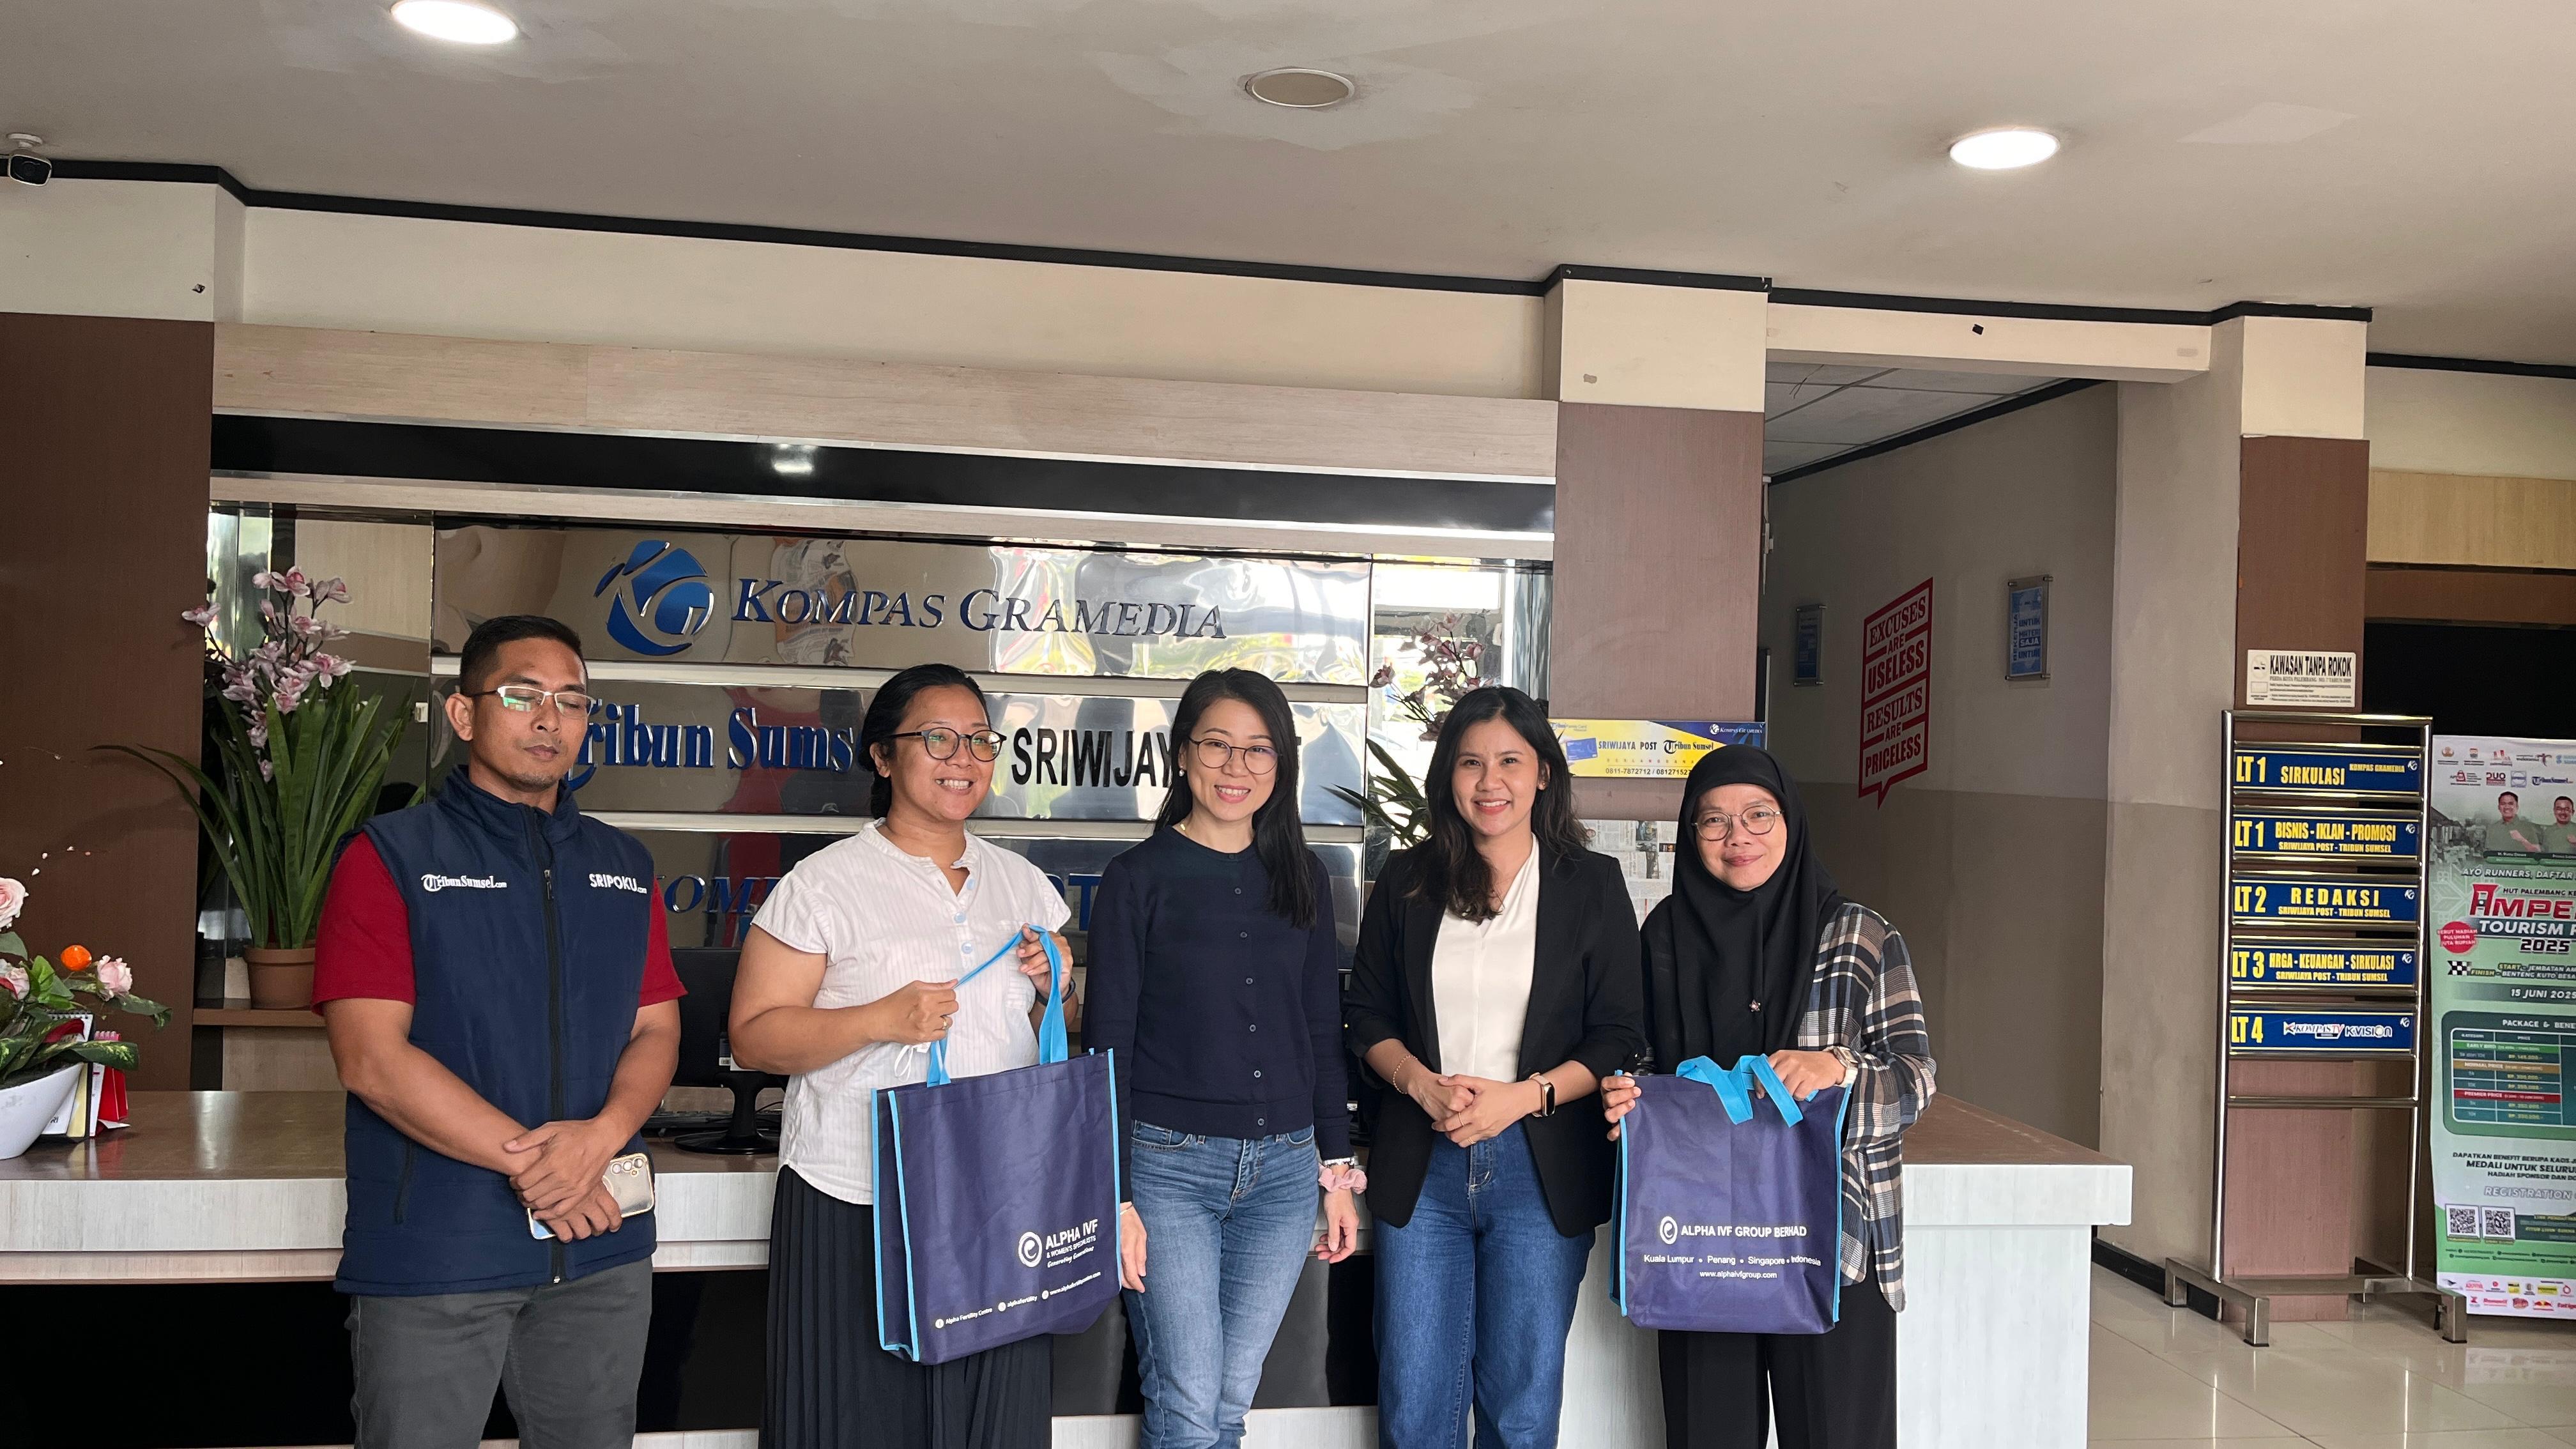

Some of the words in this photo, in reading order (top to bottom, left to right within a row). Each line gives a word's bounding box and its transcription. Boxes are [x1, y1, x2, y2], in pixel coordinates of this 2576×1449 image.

[730, 577, 947, 629] KOMPAS
[959, 588, 1227, 640] GRAMEDIA
[1869, 595, 1926, 648] EXCUSES
[1887, 632, 1905, 655] ARE
[2020, 638, 2039, 647] SAJA
[1868, 640, 1924, 694] USELESS
[2270, 655, 2303, 675] KAWASAN
[2305, 656, 2326, 676] TANPA
[2328, 657, 2352, 677] ROKOK
[1867, 686, 1923, 733] RESULTS
[727, 707, 862, 772] Sums
[1885, 722, 1902, 742] ARE
[1598, 741, 1636, 749] SRIWIJAYA
[1640, 742, 1657, 750] POST
[1663, 739, 1691, 755] Tribun
[1693, 742, 1713, 751] Sumsel
[1011, 727, 1172, 788] SRIWIJAY
[1865, 733, 1921, 778] PRICELESS
[2236, 756, 2255, 782] LT
[2256, 756, 2266, 783] 1
[2280, 766, 2345, 785] SIRKULASI
[2234, 820, 2252, 847] LT
[2255, 821, 2264, 847] 1
[2275, 822, 2309, 839] BISNIS
[2316, 823, 2345, 840] IKLAN
[2351, 824, 2396, 841] PROMOSI
[2279, 841, 2315, 851] SRIWIJAYA
[2316, 843, 2334, 852] POST
[2339, 843, 2364, 852] TRIBUN
[2365, 844, 2391, 853] SUMSEL
[421, 873, 507, 892] TribunSumsel.com
[2462, 868, 2482, 876] AYO
[2485, 868, 2532, 879] RUNNERS,
[2536, 871, 2573, 880] DAFTAR
[2234, 886, 2252, 912] LT
[2255, 886, 2267, 913] 2
[2291, 887, 2379, 907] REDAKSI
[2469, 884, 2576, 920] AMPE
[2278, 906, 2315, 916] SRIWIJAYA
[2316, 907, 2334, 916] POST
[2338, 908, 2363, 917] TRIBUN
[2365, 909, 2391, 918] SUMSEL
[2479, 920, 2564, 935] TOURISM
[2520, 939, 2570, 953] 2025
[2232, 951, 2250, 977] LT
[2252, 951, 2265, 978] 3
[2269, 953, 2293, 968] HRGA
[2299, 954, 2344, 969] KEUANGAN
[2350, 954, 2395, 970] SIRKULASI
[2276, 971, 2312, 980] SRIWIJAYA
[2313, 972, 2331, 981] POST
[2336, 972, 2361, 981] TRIBUN
[2362, 973, 2388, 982] SUMSEL
[2511, 988, 2520, 997] 15
[2523, 990, 2547, 999] JUNI
[2550, 990, 2576, 999] 2025
[2231, 1016, 2249, 1043] LT
[2251, 1016, 2264, 1043] 4
[2466, 1160, 2503, 1169] MEDALI
[2504, 1163, 2537, 1171] UNTUK
[2540, 1165, 2576, 1173] SELURU
[2484, 1186, 2572, 1200] REGISTRATION
[1046, 1227, 1080, 1250] ALPHA
[1083, 1218, 1098, 1236] IVF
[1681, 1225, 1716, 1236] ALPHA
[1718, 1225, 1732, 1236] IVF
[1735, 1226, 1772, 1238] GROUP
[1774, 1226, 1807, 1238] BERHAD
[1050, 1245, 1073, 1257] WOMEN'S
[1644, 1254, 1666, 1263] Kuala
[1667, 1255, 1694, 1264] Lumpur
[1707, 1255, 1736, 1266] Penang
[1748, 1256, 1785, 1266] Singapore
[1791, 1255, 1821, 1266] Indonesia
[1699, 1270, 1777, 1280] www.alphaivfgroup.com
[946, 1316, 960, 1325] Alpha
[960, 1312, 978, 1321] Fertility
